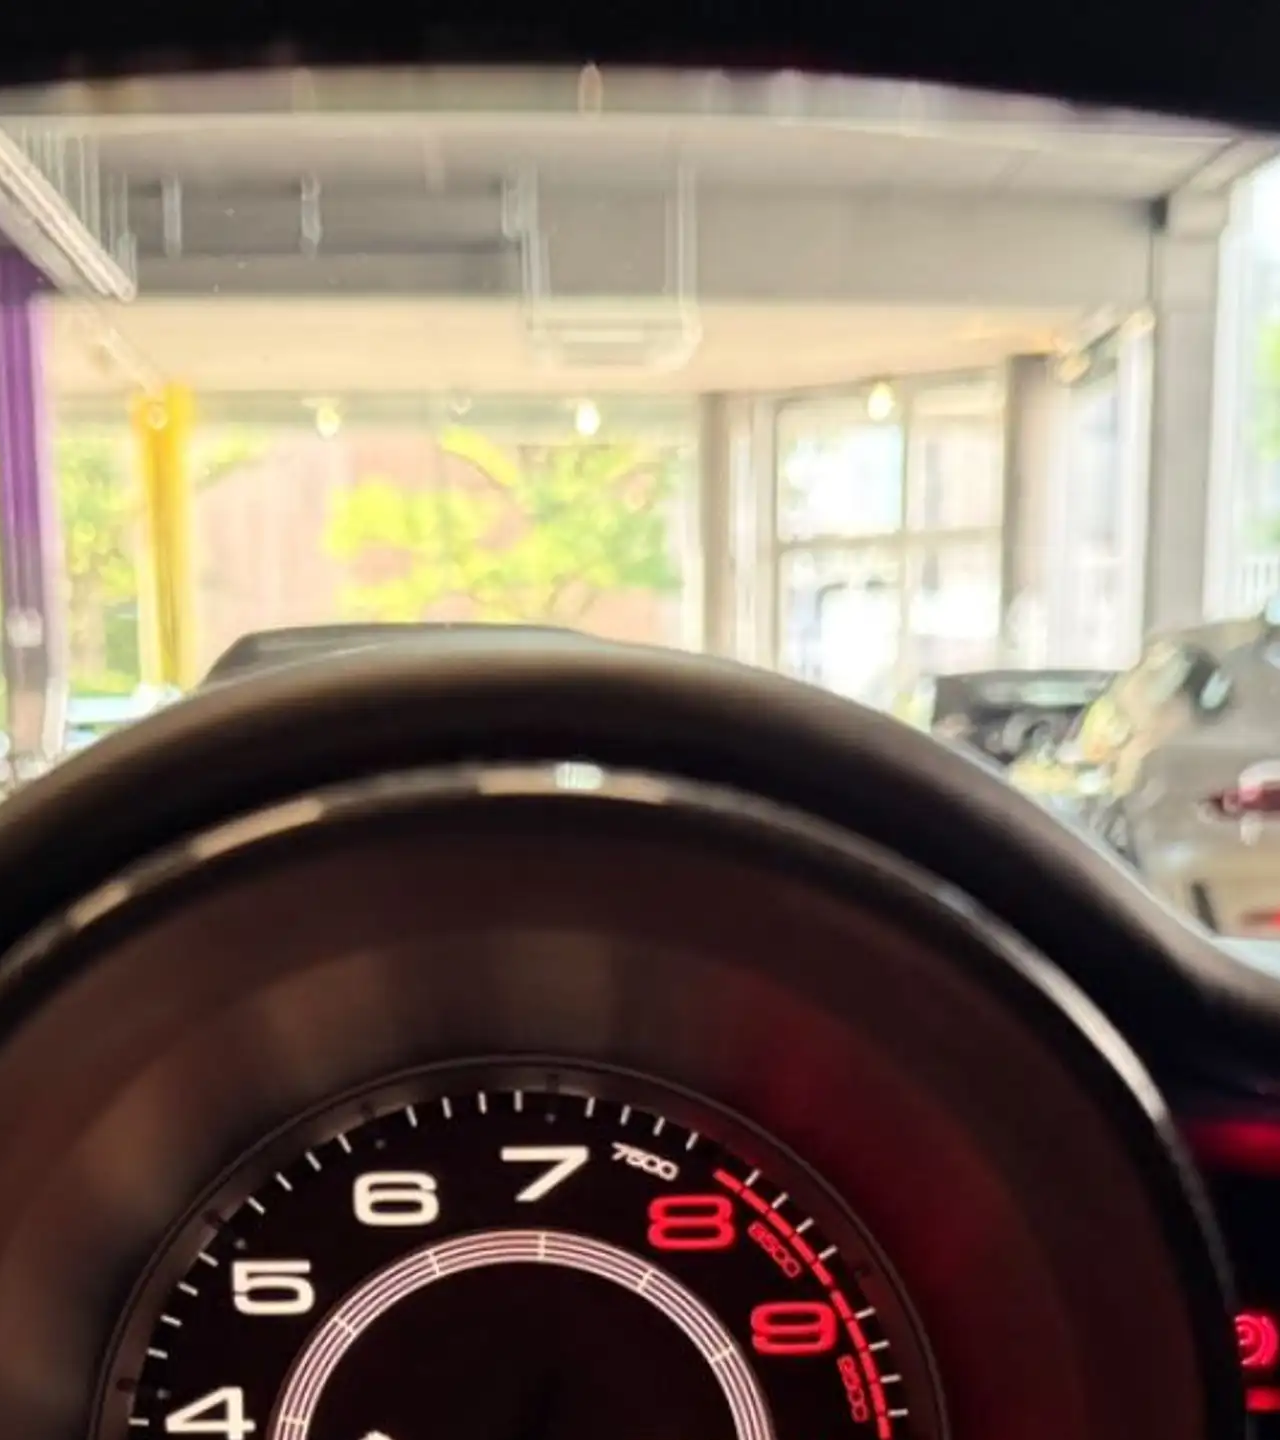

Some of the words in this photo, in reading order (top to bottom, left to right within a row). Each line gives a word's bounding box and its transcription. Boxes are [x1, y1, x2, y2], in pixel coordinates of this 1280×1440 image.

[502, 1146, 588, 1201] 7
[613, 1143, 677, 1180] 7500
[354, 1172, 438, 1225] 6
[648, 1195, 734, 1250] 8
[233, 1261, 314, 1314] 5
[750, 1302, 837, 1354] 9
